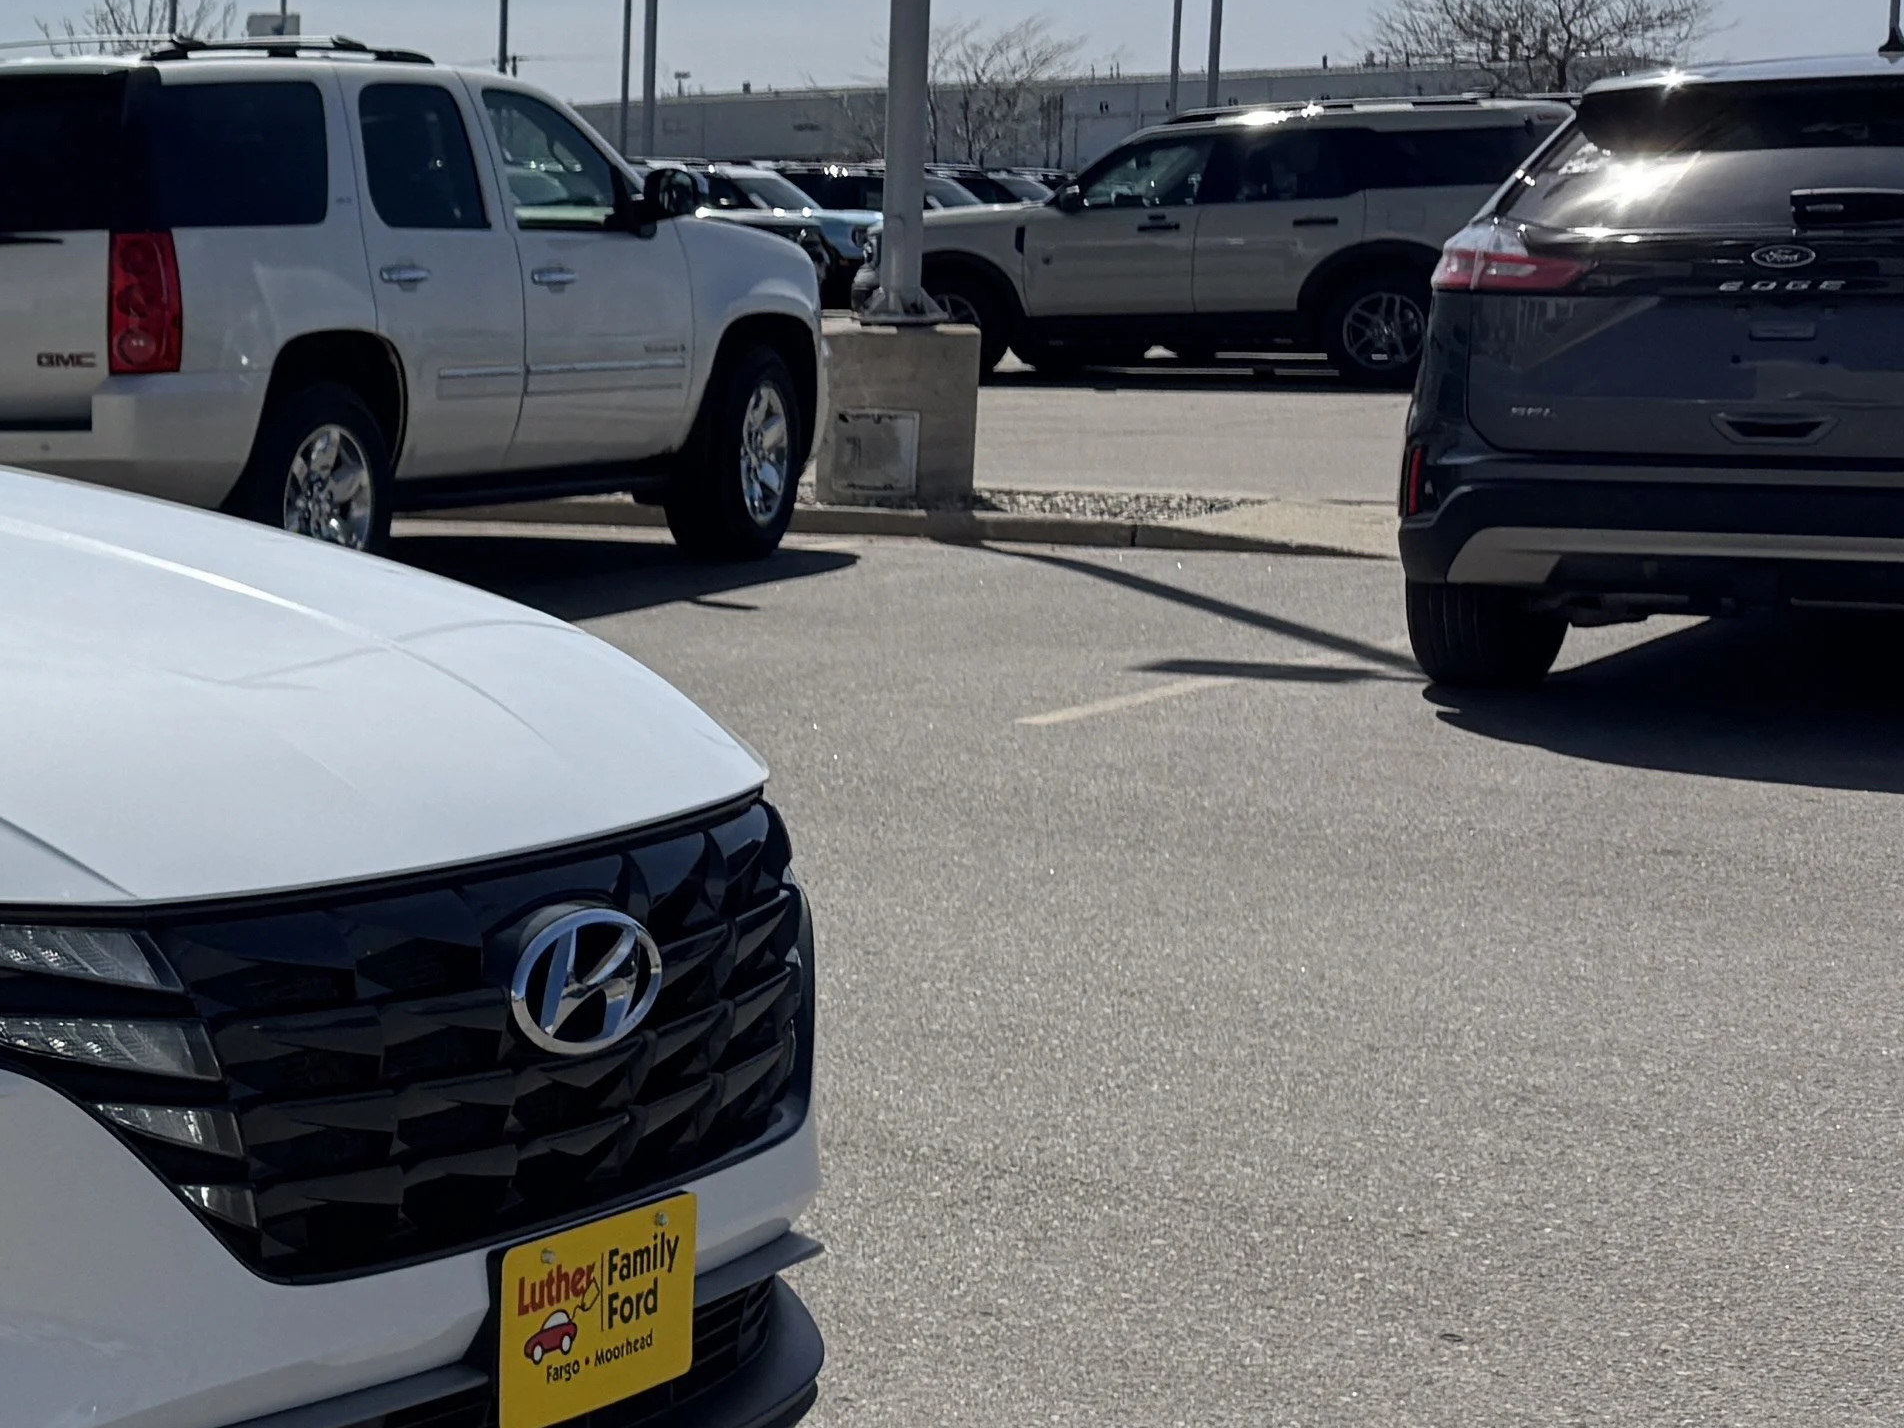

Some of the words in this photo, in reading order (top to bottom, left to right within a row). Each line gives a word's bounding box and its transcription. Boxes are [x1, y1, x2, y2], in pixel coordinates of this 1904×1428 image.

[36, 352, 97, 368] GMC
[607, 1231, 680, 1287] Family
[517, 1261, 596, 1317] Luther
[607, 1276, 659, 1331] Ford
[545, 1358, 581, 1385] Fargo
[593, 1328, 654, 1369] Moorhead
